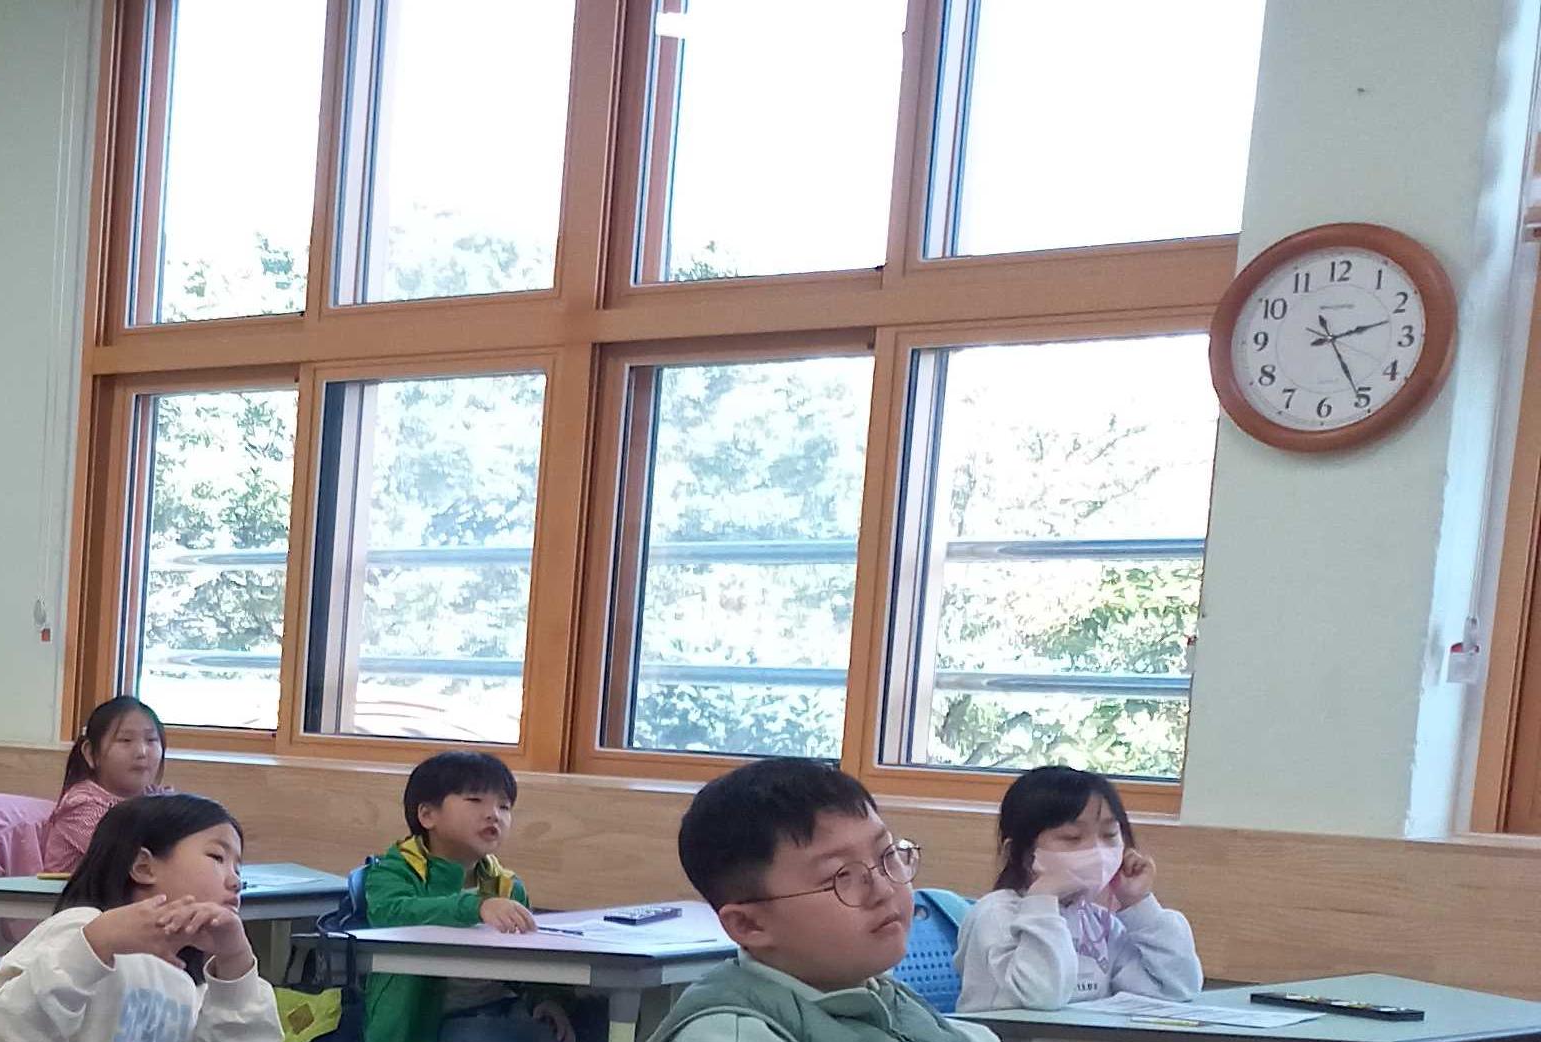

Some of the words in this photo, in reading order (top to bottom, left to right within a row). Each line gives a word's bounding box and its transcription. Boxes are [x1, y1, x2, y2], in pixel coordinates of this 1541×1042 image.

[1329, 259, 1353, 282] 12
[1374, 269, 1383, 290] 1
[1293, 272, 1311, 293] 11
[1262, 298, 1287, 320] 10
[1392, 292, 1408, 313] 2
[1253, 331, 1269, 352] 9
[1397, 325, 1415, 347] 3
[1258, 364, 1276, 386] 8
[1383, 360, 1398, 381] 4
[1282, 388, 1297, 410] 7
[1317, 396, 1332, 418] 6
[1354, 386, 1372, 409] 5
